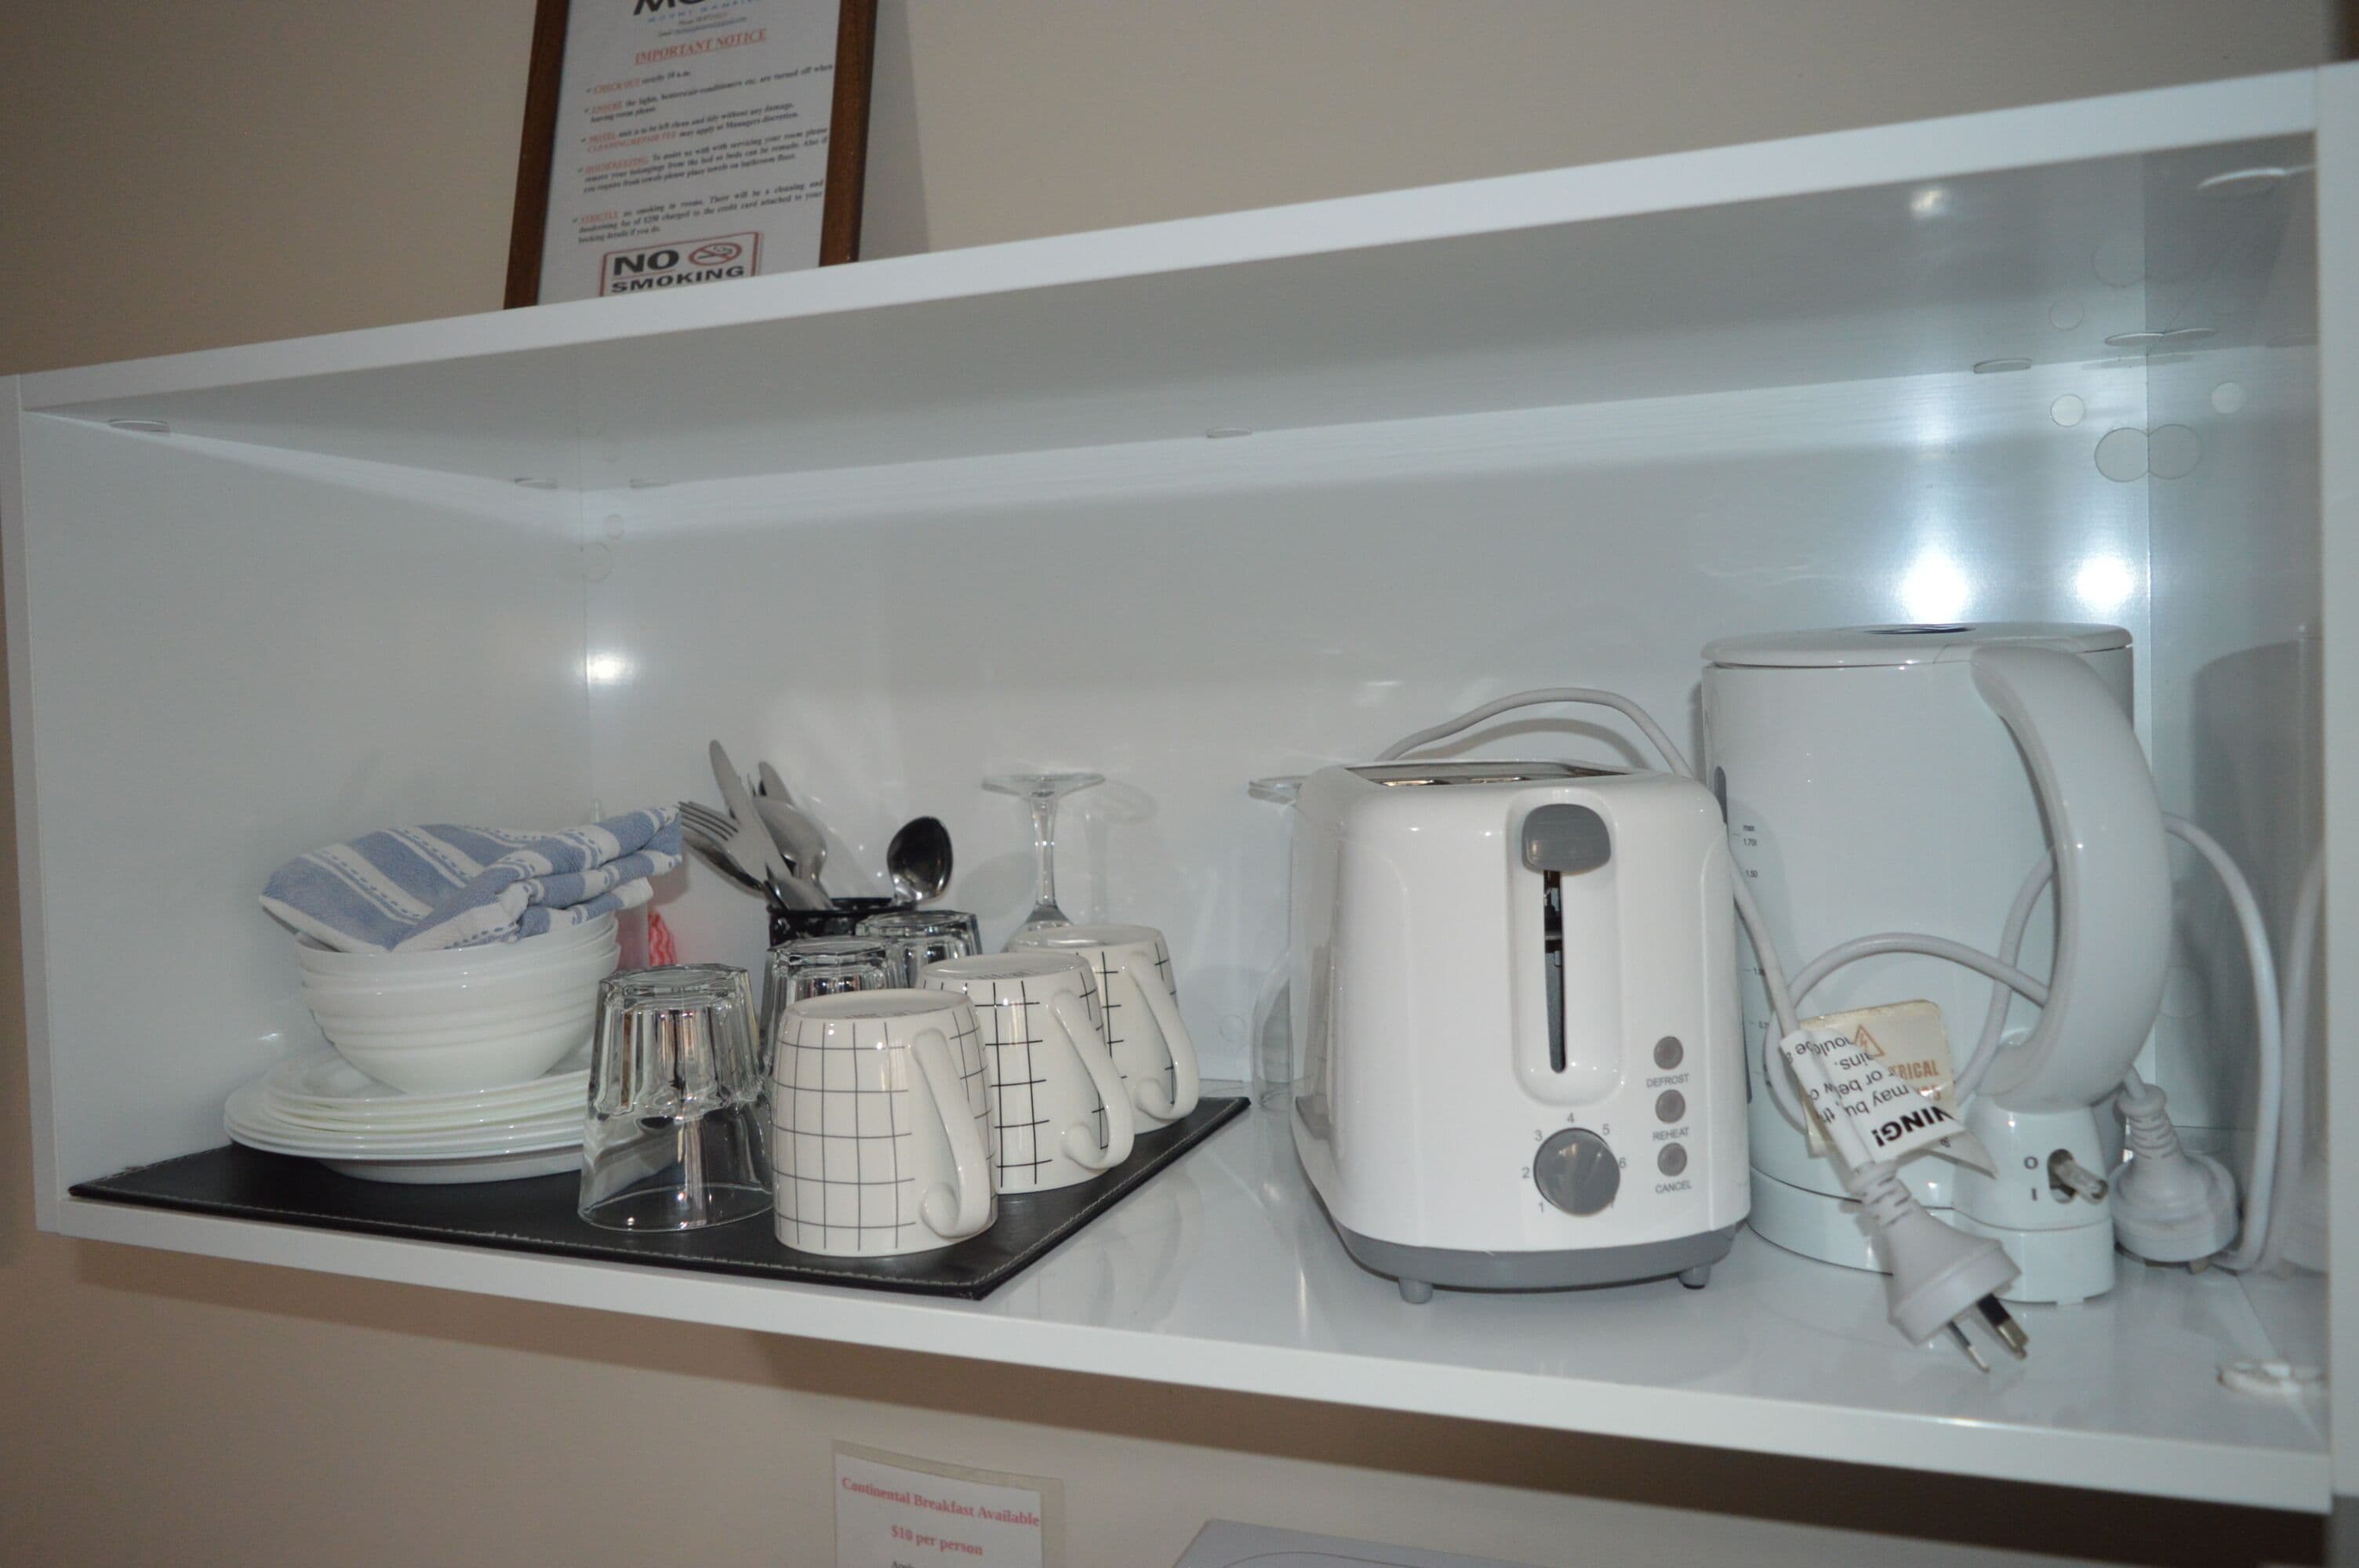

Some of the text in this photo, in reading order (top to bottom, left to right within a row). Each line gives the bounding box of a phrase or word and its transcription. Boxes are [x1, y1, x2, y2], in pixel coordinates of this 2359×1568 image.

[634, 28, 766, 65] IMPORTANT NOTICE
[801, 66, 812, 74] off
[722, 109, 747, 119] without
[662, 210, 690, 222] charged
[612, 249, 679, 276] NO
[611, 265, 744, 293] SMOKING
[1646, 1073, 1690, 1088] DEFROST
[1866, 1070, 1882, 1087] or
[1872, 1083, 1910, 1108] may
[1566, 1112, 1575, 1123] 4
[1535, 1130, 1543, 1142] 3
[1602, 1124, 1610, 1135] 5
[1652, 1127, 1690, 1141] REHEAT
[1619, 1157, 1627, 1169] 6
[1521, 1167, 1530, 1179] 2
[1655, 1181, 1692, 1194] CANCEL
[1538, 1202, 1544, 1213] 1
[841, 1477, 1041, 1526] Continental Breakfast Available
[891, 1524, 983, 1556] $10 per person
